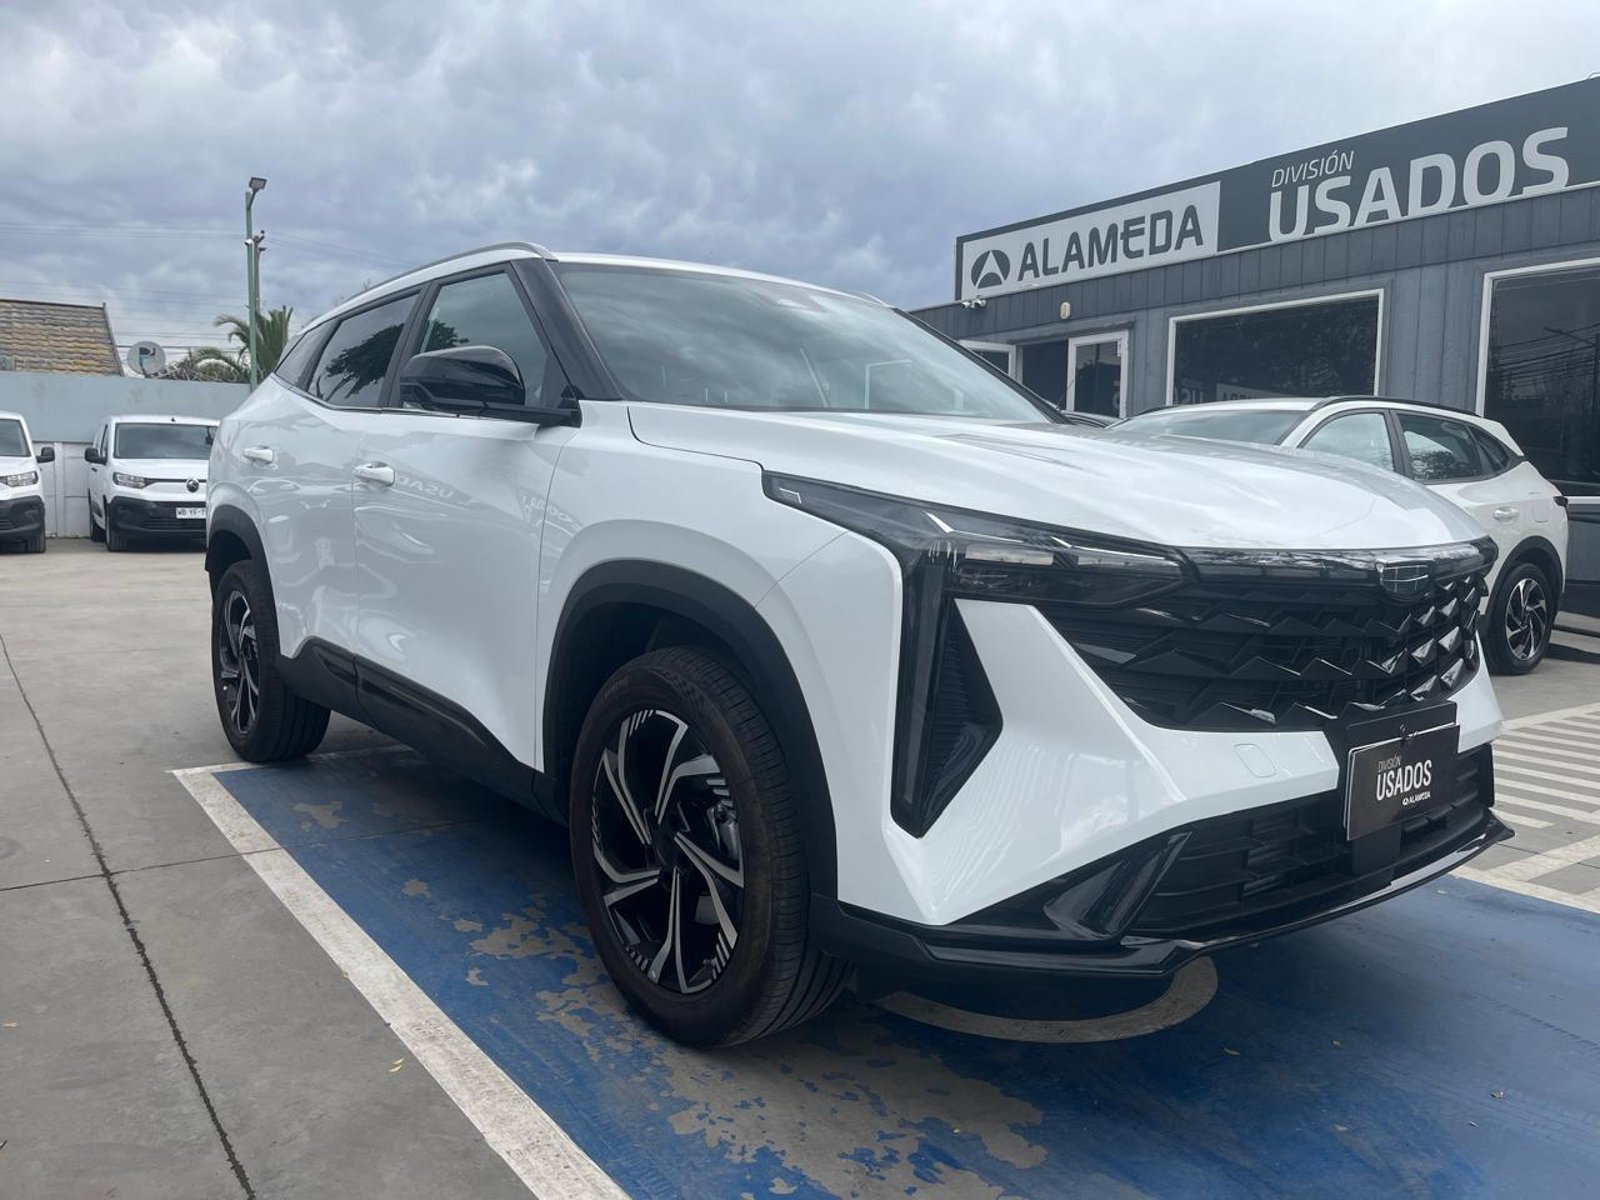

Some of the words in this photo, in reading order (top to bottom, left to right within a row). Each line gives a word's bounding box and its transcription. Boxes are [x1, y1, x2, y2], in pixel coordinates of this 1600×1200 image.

[1269, 127, 1570, 241] USADOS
[1272, 150, 1354, 188] DIVISIÓN
[1017, 205, 1204, 282] ALAMEDA
[1376, 760, 1432, 801] USADOS
[1378, 754, 1402, 772] DIVISIÓN
[1409, 791, 1431, 803] ALAMEDA
